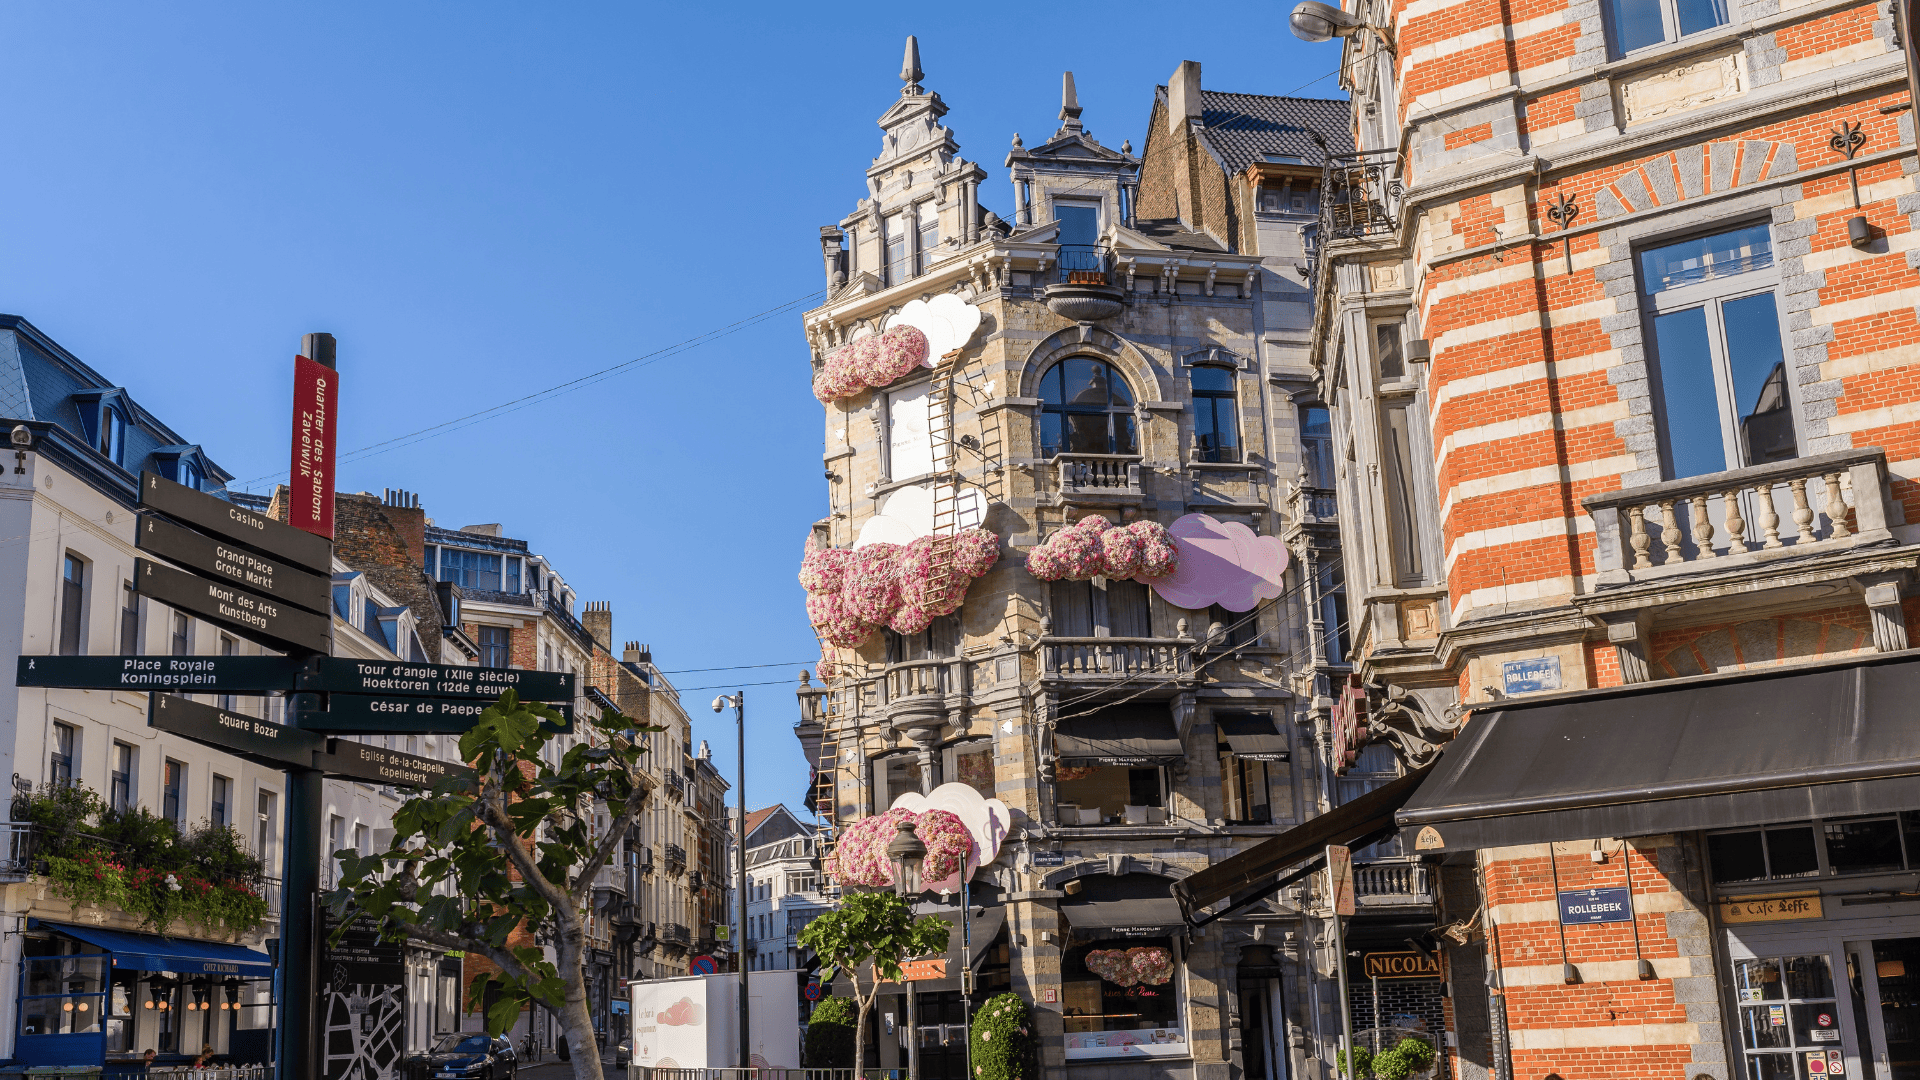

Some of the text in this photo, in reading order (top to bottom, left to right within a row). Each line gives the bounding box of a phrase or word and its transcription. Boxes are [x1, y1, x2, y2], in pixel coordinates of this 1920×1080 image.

[300, 411, 313, 477] Zavelwijk
[312, 378, 326, 521] Quartier des Sablons
[229, 509, 264, 530] Casino
[217, 547, 273, 575] Grand'Place
[215, 560, 272, 589] Grote Markt
[209, 585, 277, 617] Mont des Arts
[219, 603, 267, 629] Kunstberg
[124, 659, 215, 672] Place Royale
[357, 664, 520, 683] Tour d'angle (XIIe siècle)
[121, 673, 216, 685] Koningsplein
[362, 677, 430, 691] Hoektoren
[436, 682, 470, 693] (12de
[1506, 669, 1557, 683] ROLLEBEEK
[370, 701, 483, 716] César de Paepe
[219, 713, 279, 739] Square Bozar
[360, 749, 445, 775] Eglise de-la-Chapelle
[379, 766, 427, 784] Kapellekerk
[1567, 902, 1622, 915] ROLLEBEEK
[1778, 899, 1810, 914] Leffe
[204, 963, 216, 971] CHEZ
[1370, 956, 1439, 973] NICOLA
[1046, 992, 1053, 1000] H
